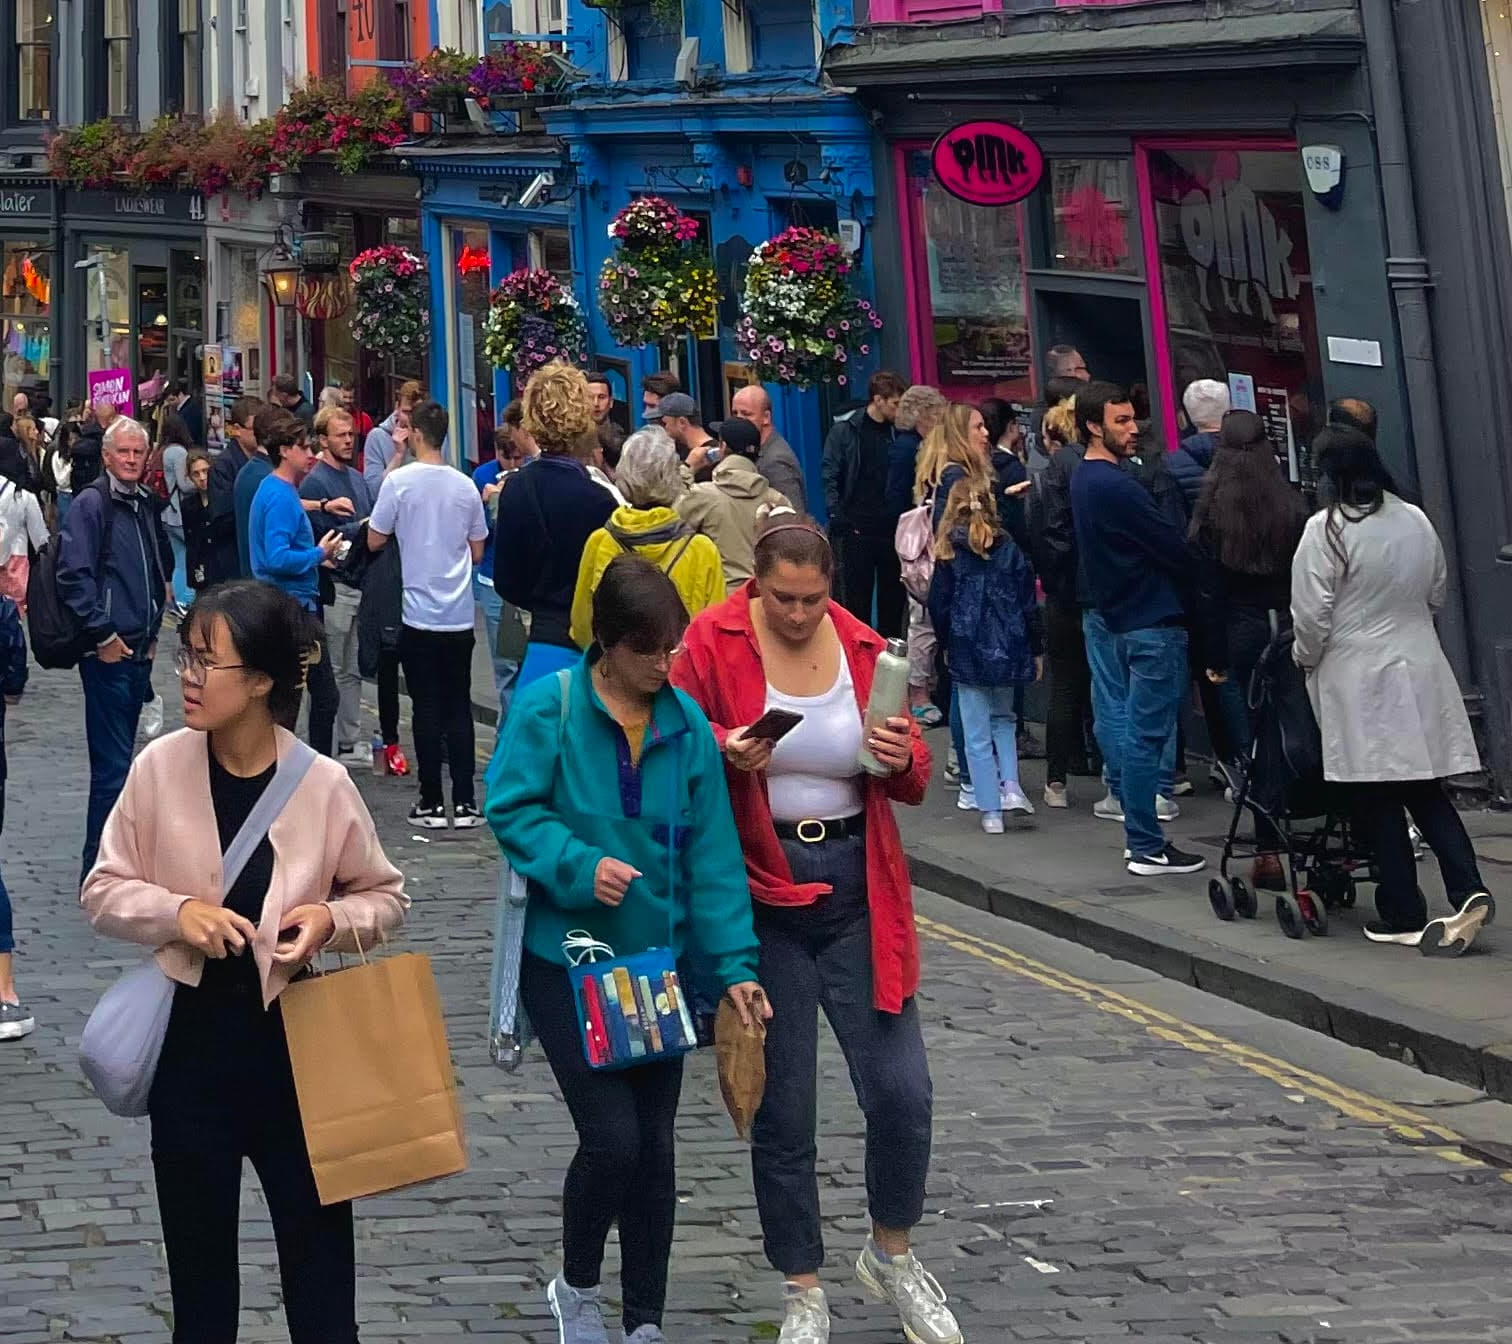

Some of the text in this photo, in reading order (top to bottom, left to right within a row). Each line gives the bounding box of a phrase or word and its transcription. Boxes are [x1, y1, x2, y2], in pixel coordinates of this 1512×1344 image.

[1306, 156, 1331, 170] CSS
[114, 197, 166, 214] LADIESWEAR
[93, 375, 125, 397] SIMON
